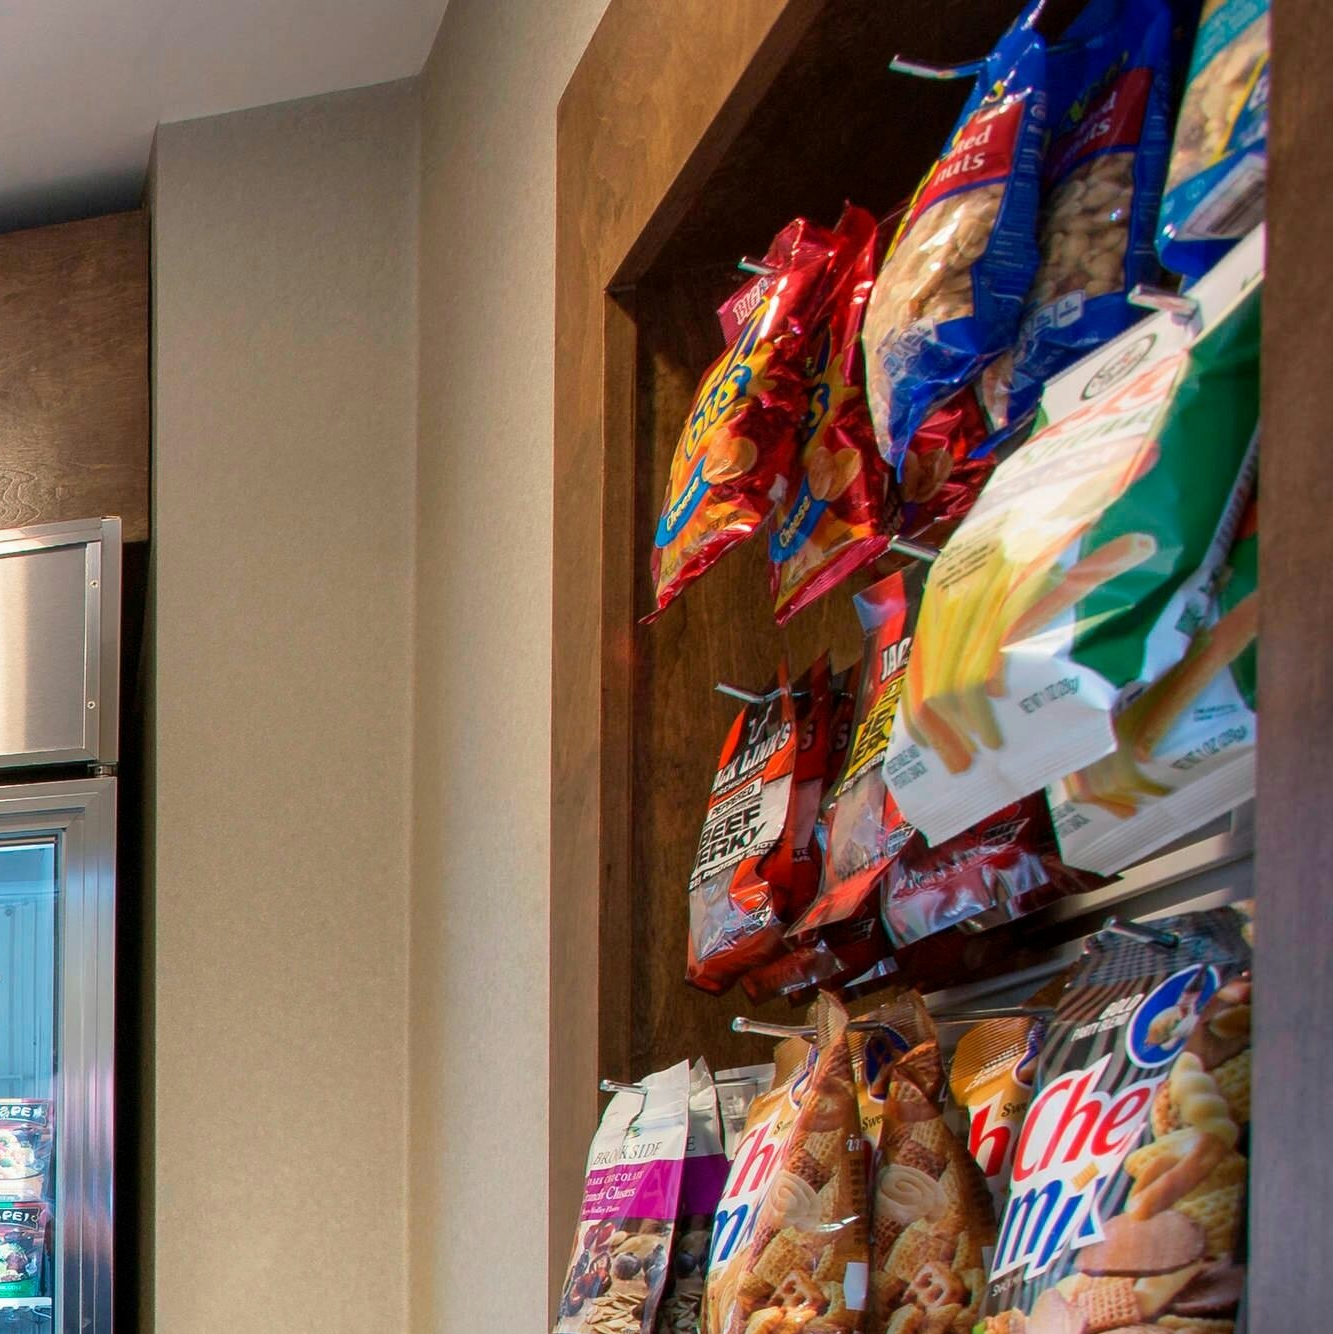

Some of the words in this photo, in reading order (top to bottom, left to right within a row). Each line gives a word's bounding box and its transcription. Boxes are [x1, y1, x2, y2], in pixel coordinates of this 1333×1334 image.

[779, 495, 812, 548] Cheese
[697, 821, 767, 869] ERKY
[701, 804, 761, 847] BEEF
[1013, 1066, 1153, 1184] Che
[2, 1211, 30, 1223] PEI
